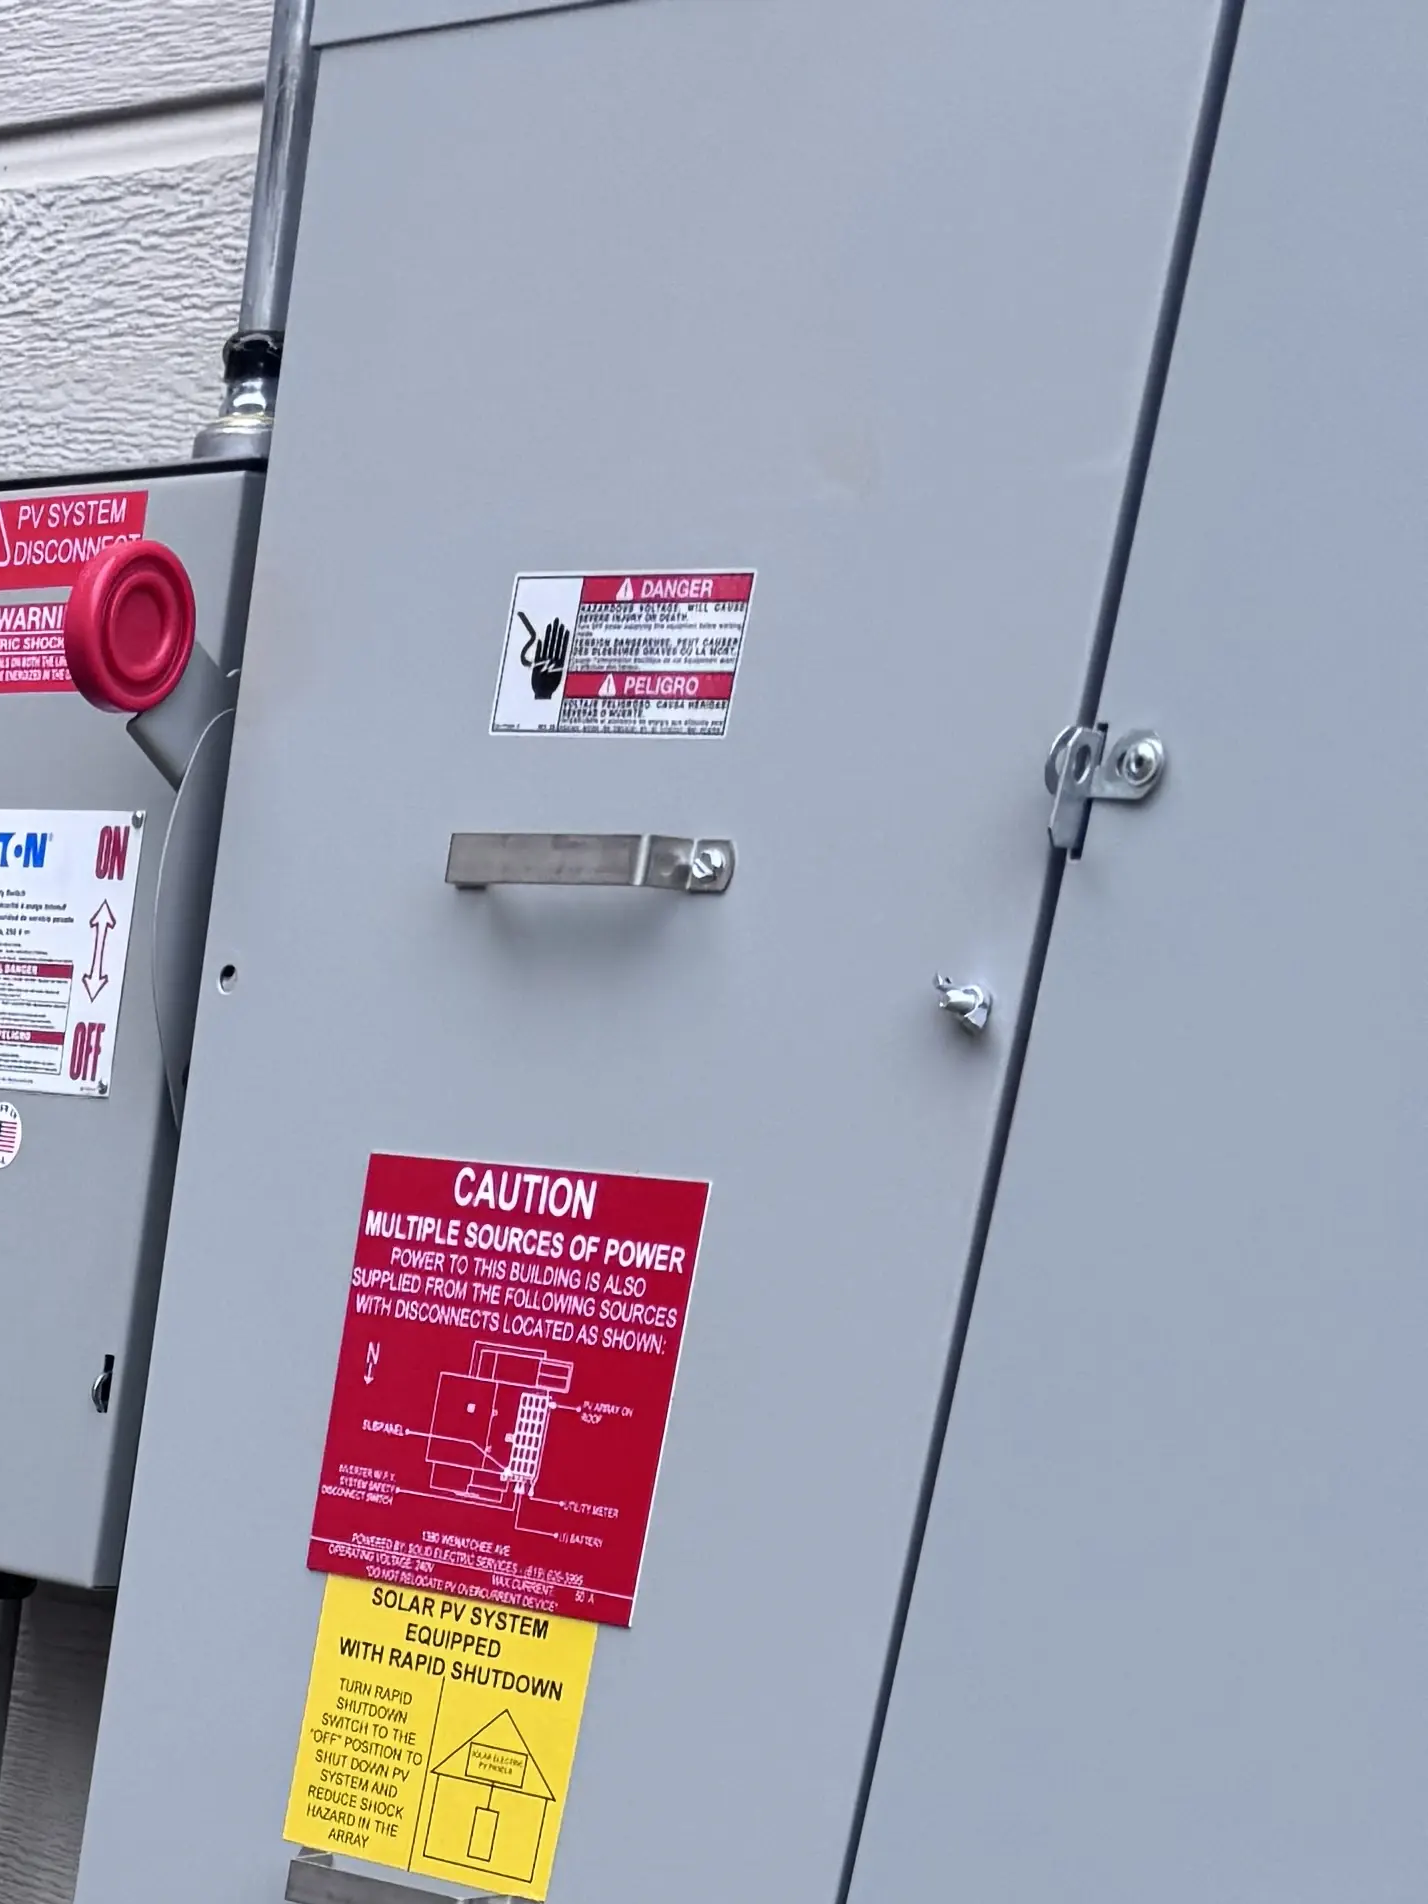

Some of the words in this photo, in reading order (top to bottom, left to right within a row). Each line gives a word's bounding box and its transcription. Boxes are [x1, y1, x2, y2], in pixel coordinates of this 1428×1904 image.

[17, 504, 45, 530] PV
[47, 497, 128, 528] SYSTEM
[641, 579, 713, 598] DANGER
[578, 614, 609, 622] SEVERE
[581, 603, 634, 613] HAZARDOUS
[688, 603, 708, 612] WILL
[714, 603, 744, 612] CAUSE
[23, 636, 64, 650] SHOCK
[623, 676, 699, 696] PELIGRO
[95, 825, 130, 880] ON
[4, 964, 38, 975] DANGER
[69, 1021, 106, 1081] OFF
[453, 1166, 598, 1221] CAUTION
[364, 1208, 460, 1246] MULTIPLE
[465, 1221, 562, 1259] SOURCES
[569, 1235, 599, 1262] OF
[604, 1237, 686, 1273] POWER
[389, 1247, 444, 1270] POWER
[448, 1253, 469, 1275] TO
[473, 1256, 506, 1280] THIS
[509, 1259, 581, 1290] BUILDING
[584, 1269, 599, 1290] IS
[604, 1271, 646, 1298] ALSO
[351, 1267, 421, 1294] SUPPLIED
[424, 1275, 467, 1301] FROM
[471, 1281, 501, 1305] THE
[503, 1285, 596, 1317] FOLLOWING
[599, 1298, 678, 1329] SOURCES
[355, 1294, 392, 1317] WITH
[394, 1299, 500, 1333] DISCONNECTS
[503, 1313, 574, 1342] LOCATED
[576, 1322, 598, 1346] AS
[602, 1326, 667, 1356] SHOWN:
[365, 1341, 380, 1365] N
[361, 1419, 405, 1436] SUBPANEL
[321, 1484, 365, 1500] DISCONNECT
[366, 1492, 393, 1505] SWITCH
[564, 1500, 590, 1515] UTILITY
[592, 1505, 619, 1519] METER
[328, 1544, 374, 1562] OPERATING
[352, 1533, 392, 1550] POWERED
[408, 1543, 432, 1557] SOLID
[433, 1547, 474, 1567] ELECTRIC
[476, 1555, 518, 1575] SERVICES
[371, 1587, 434, 1619] SOLAR
[439, 1602, 468, 1623] PV
[470, 1605, 550, 1640] SYSTEM
[405, 1623, 502, 1659] EQUIPPED
[339, 1637, 383, 1664] WITH
[389, 1647, 445, 1676] RAPID
[451, 1661, 563, 1701] SHUTDOWN
[339, 1678, 372, 1696] TURN
[374, 1686, 413, 1706] RAPID
[335, 1697, 408, 1724] SHUTDOWN
[321, 1713, 369, 1735] SWITCH
[371, 1724, 389, 1739] TO
[392, 1728, 417, 1746] THE
[310, 1728, 342, 1746] "OFF"
[344, 1737, 402, 1760] POSITION
[407, 1752, 423, 1766] TO
[315, 1749, 348, 1768] SHUT
[350, 1758, 388, 1777] DOWN
[392, 1766, 410, 1782] PV
[319, 1768, 370, 1791] SYSTEM
[371, 1782, 399, 1799] AND
[307, 1785, 358, 1808] REDUCE
[360, 1798, 404, 1820] SHOCK
[306, 1803, 356, 1827] HAZARD
[358, 1816, 371, 1831] IN
[374, 1819, 399, 1838] THE
[328, 1828, 370, 1849] ARRAY
